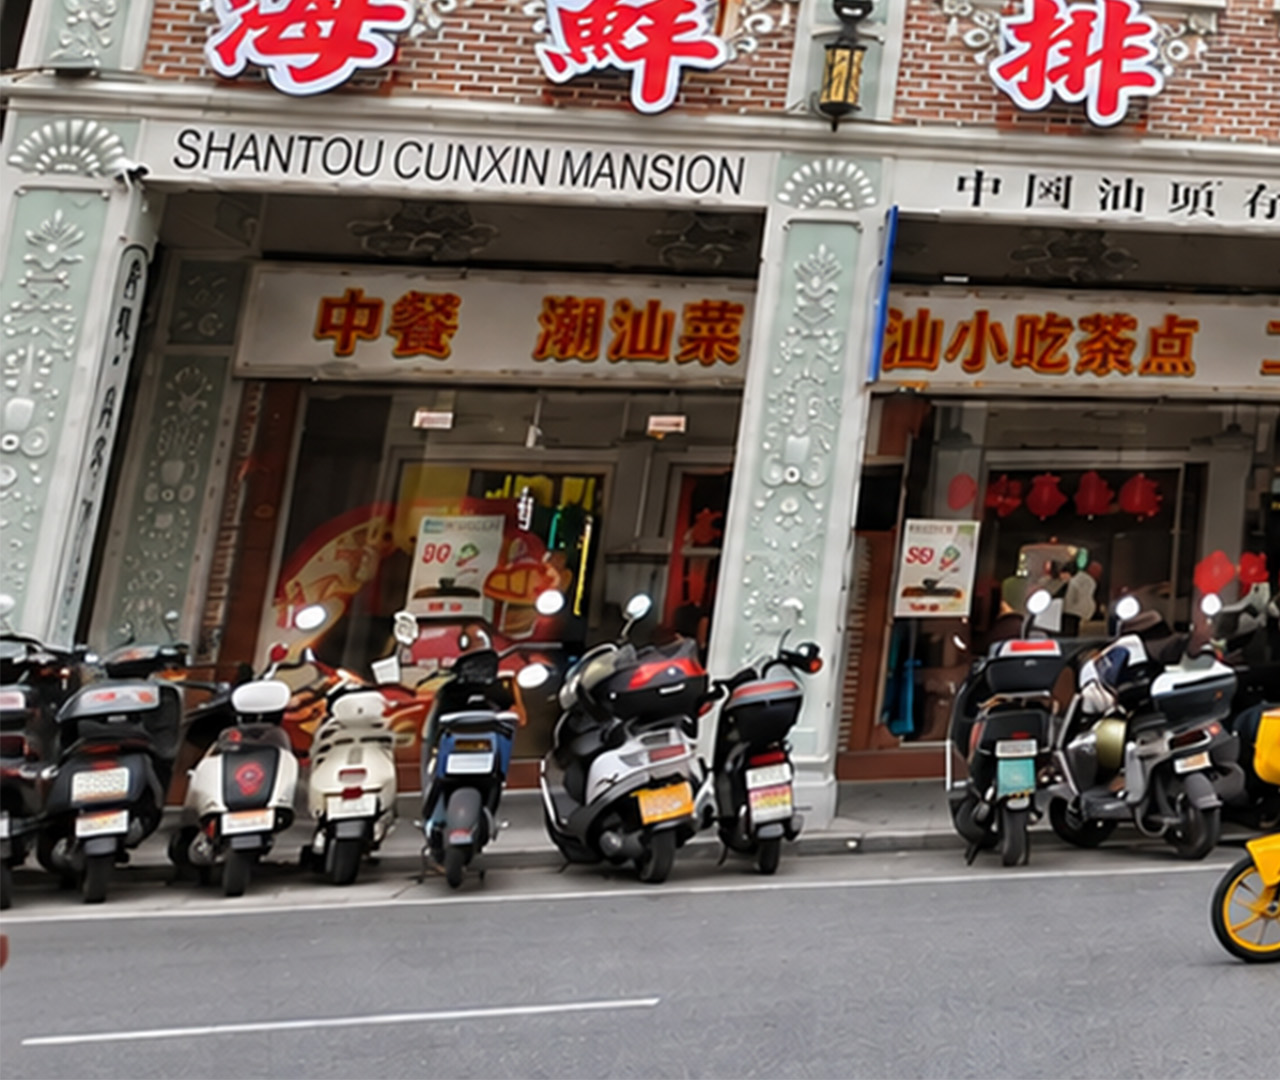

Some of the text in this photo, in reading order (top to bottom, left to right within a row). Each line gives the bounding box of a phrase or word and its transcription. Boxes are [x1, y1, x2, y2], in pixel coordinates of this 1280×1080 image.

[173, 128, 746, 195] SHANTOU CUNXIN MANSION
[313, 287, 746, 366] 中餐 潮汕菜
